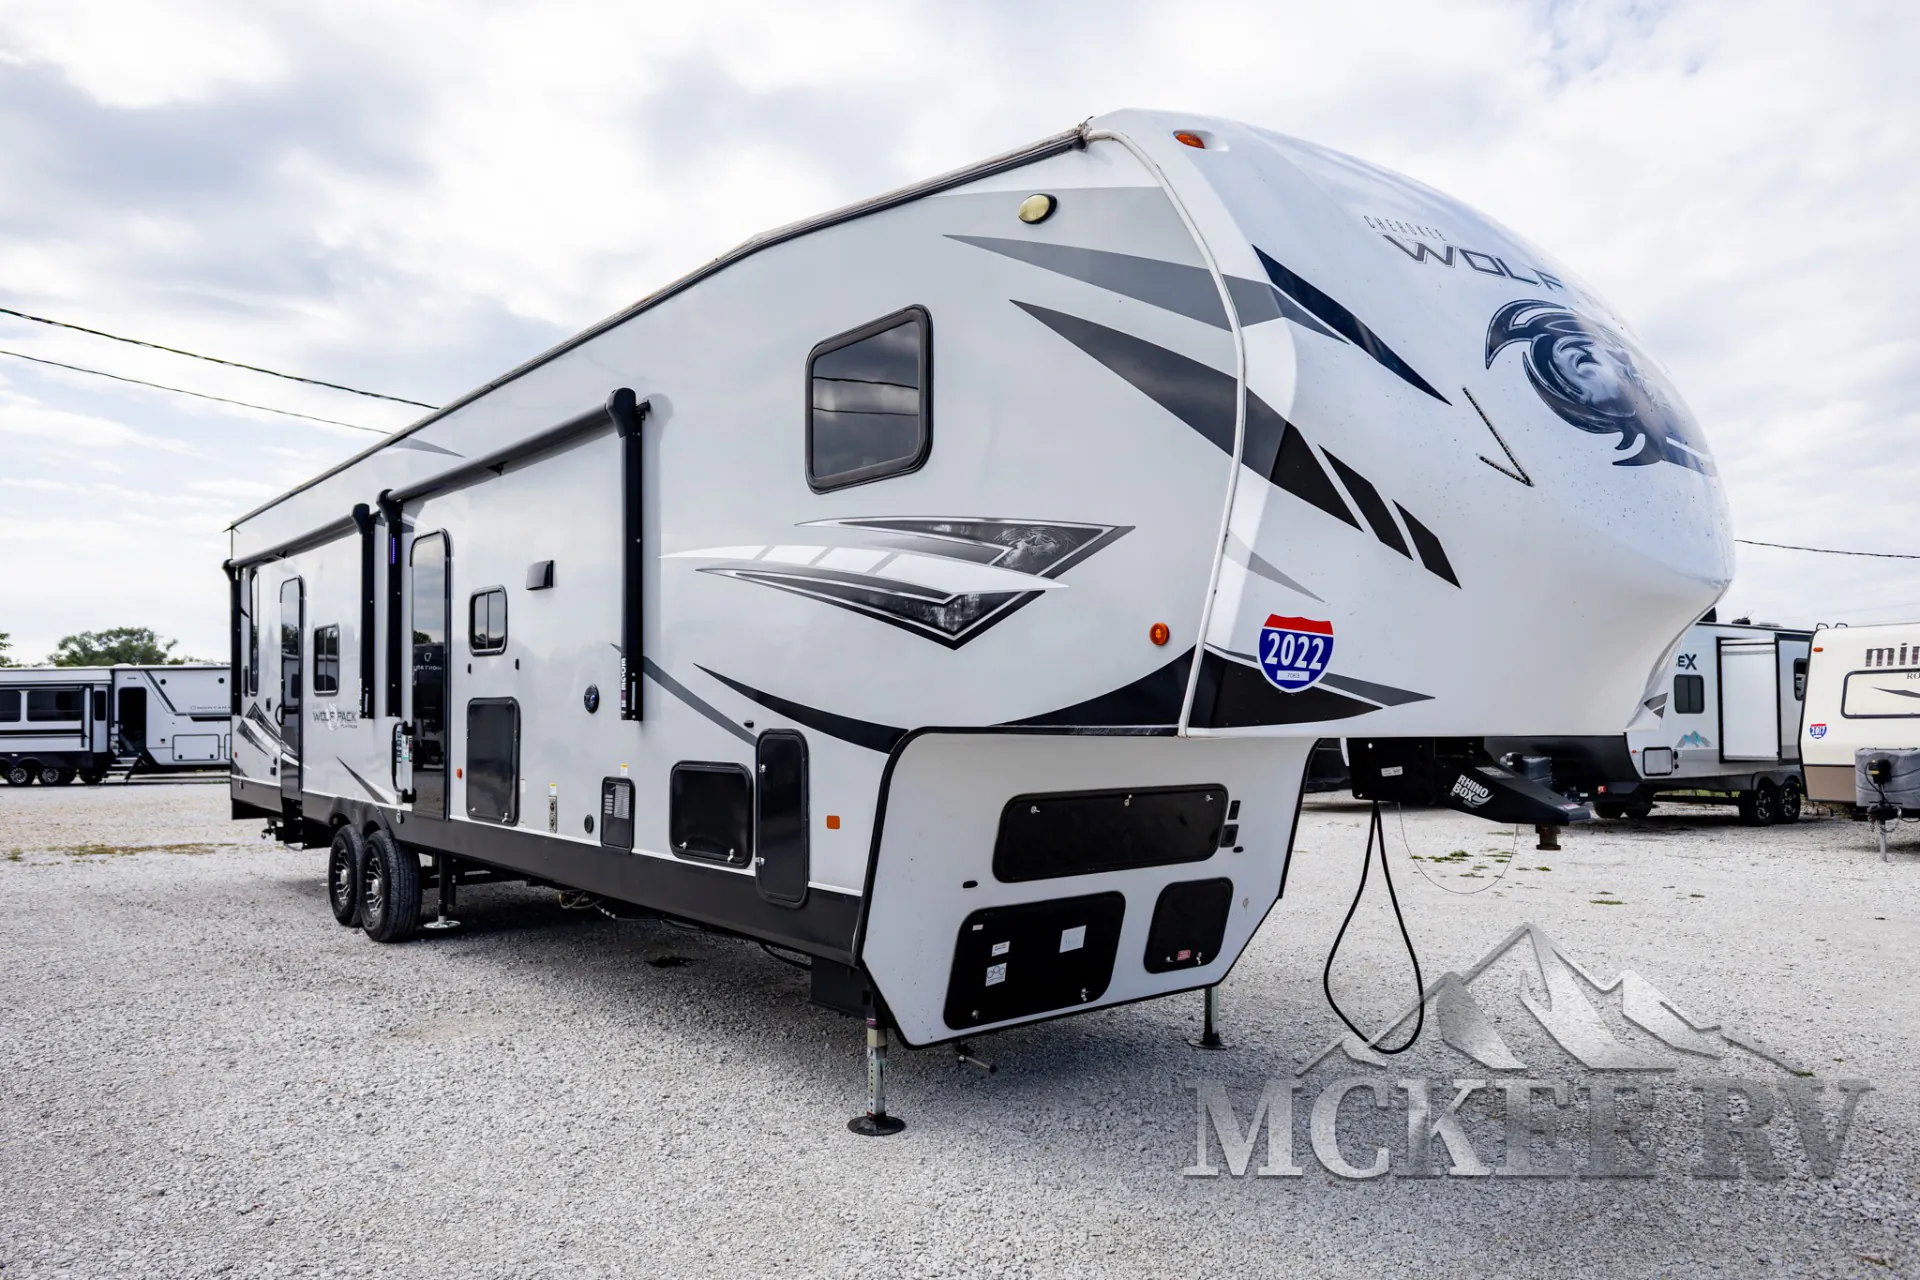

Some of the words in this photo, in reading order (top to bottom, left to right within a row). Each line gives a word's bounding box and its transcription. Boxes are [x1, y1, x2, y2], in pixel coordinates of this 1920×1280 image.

[1363, 215, 1447, 241] CHEROKEE
[1379, 232, 1565, 291] WOLF
[1264, 632, 1324, 670] 2022
[1676, 653, 1697, 671] EX
[312, 711, 336, 722] WOLF
[336, 711, 358, 722] PACK
[1452, 782, 1475, 802] BOX
[1457, 774, 1489, 798] RHINO
